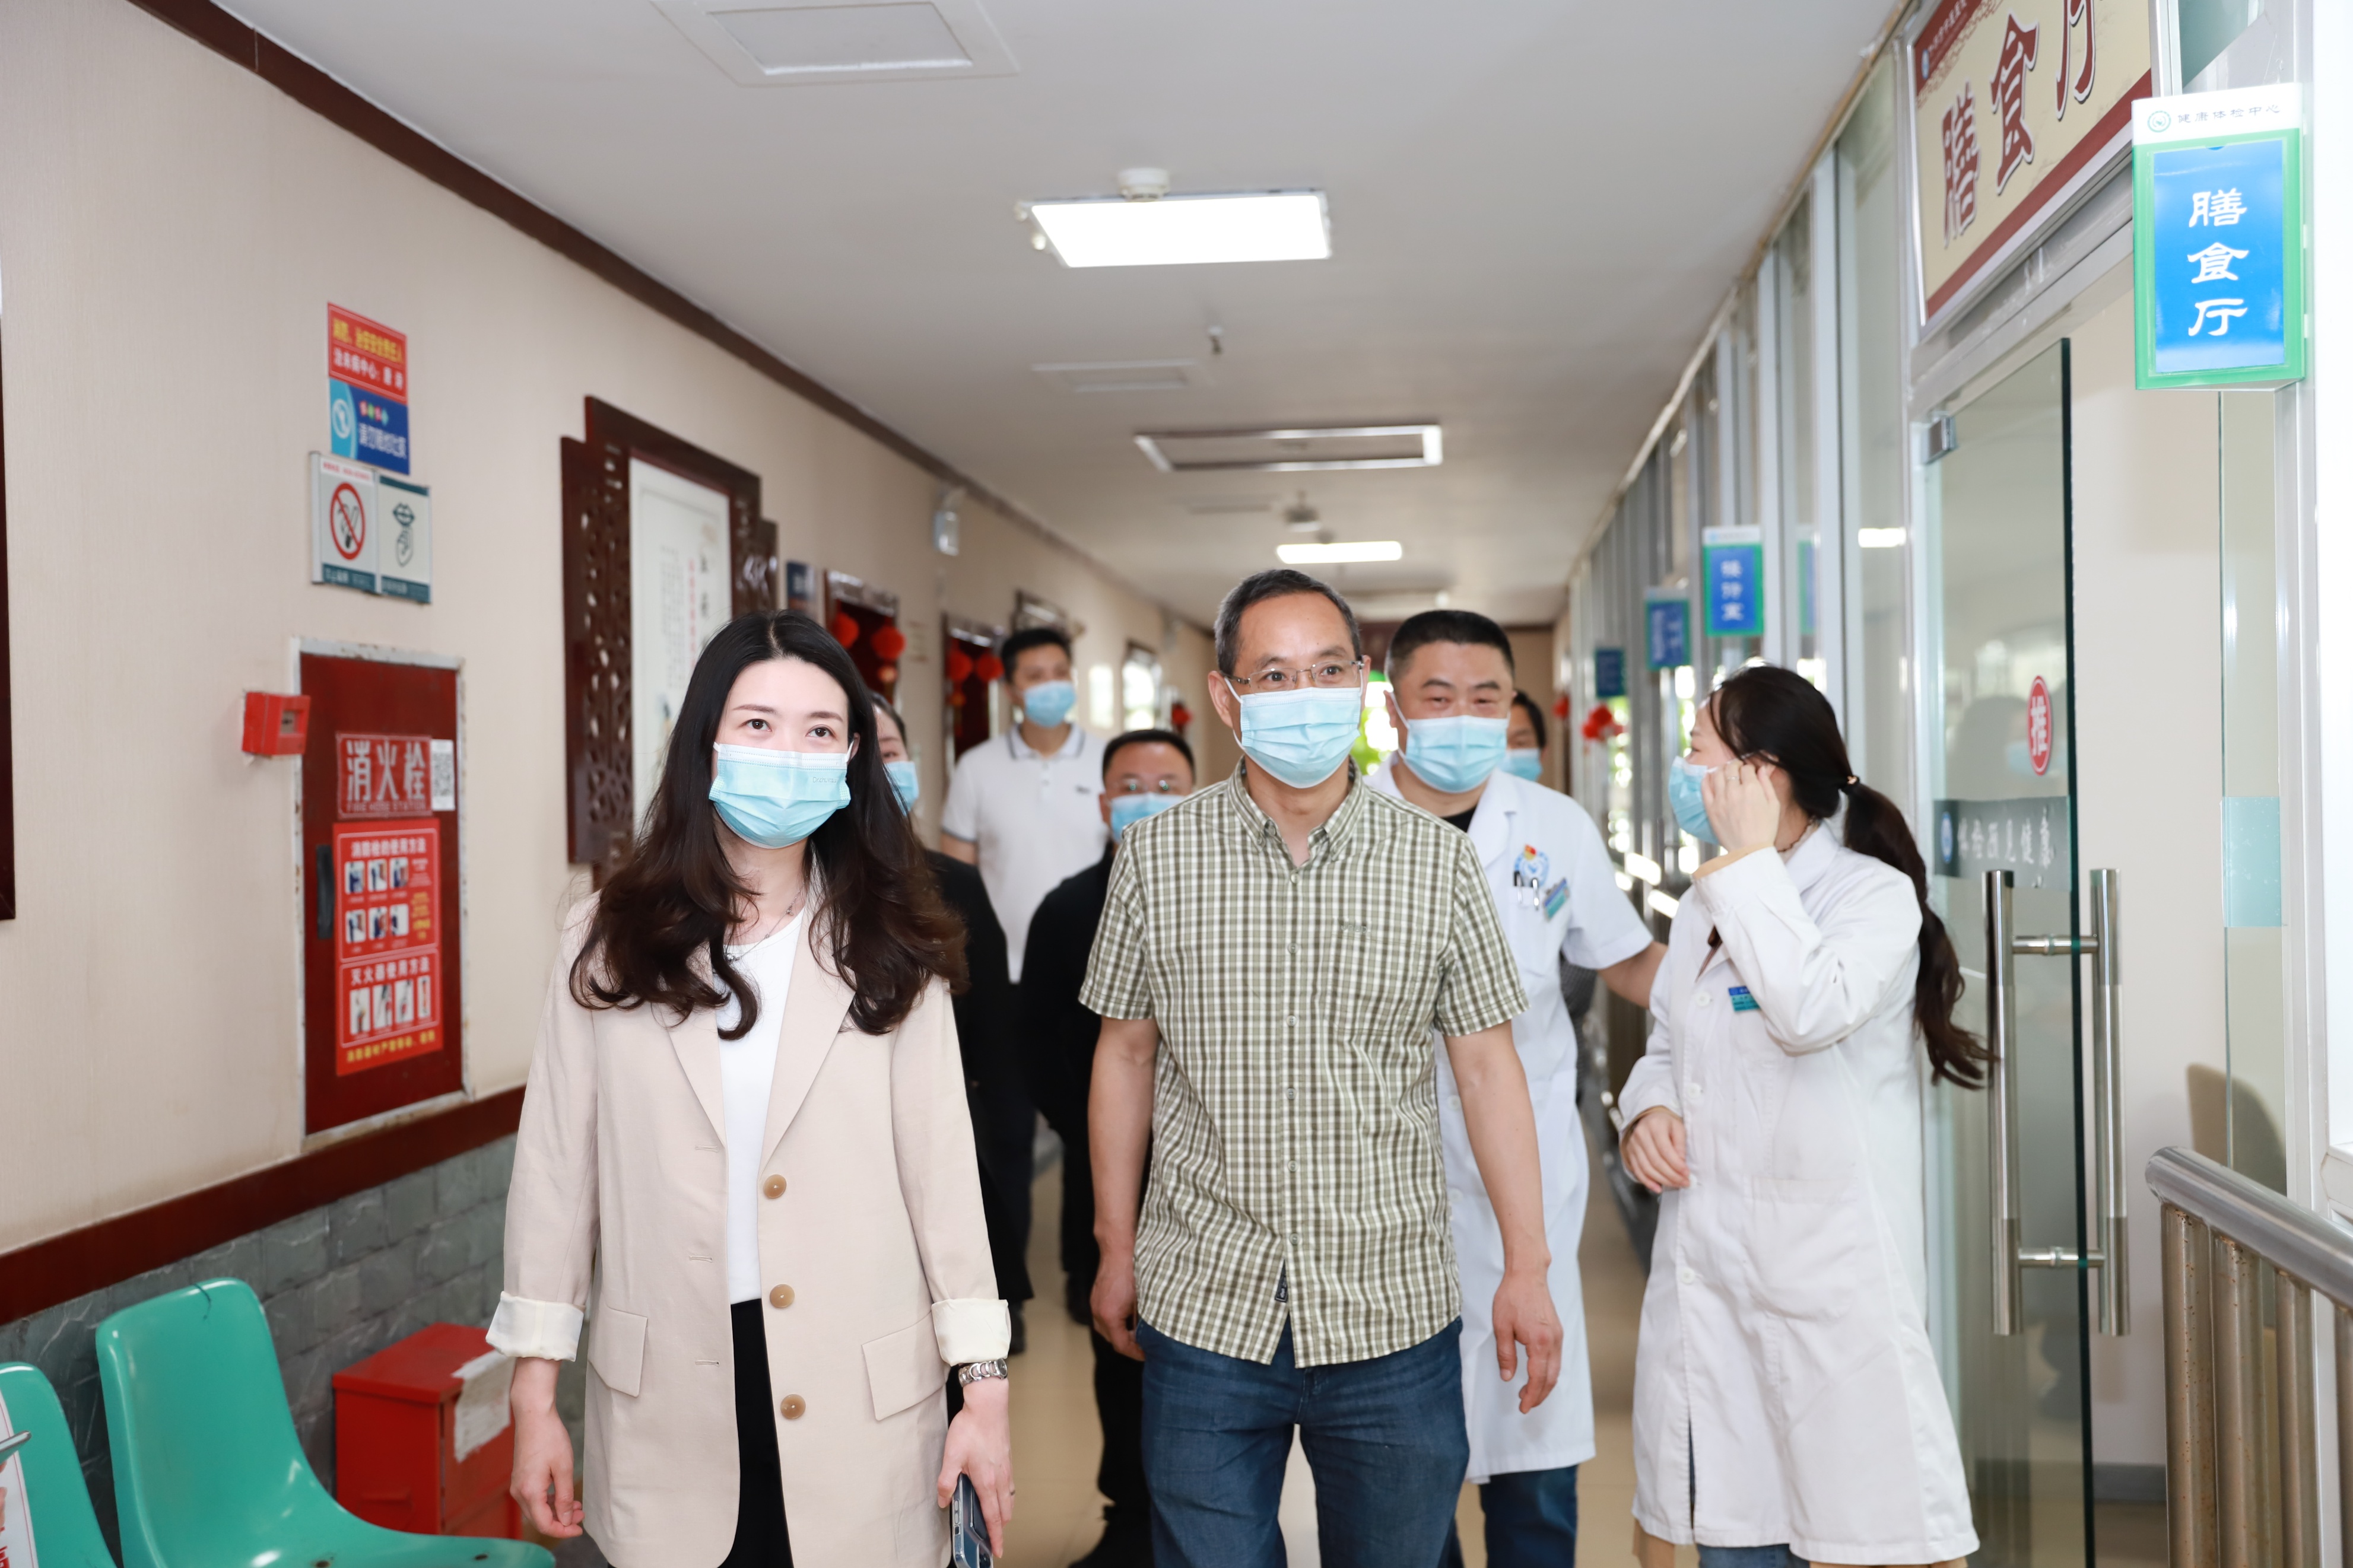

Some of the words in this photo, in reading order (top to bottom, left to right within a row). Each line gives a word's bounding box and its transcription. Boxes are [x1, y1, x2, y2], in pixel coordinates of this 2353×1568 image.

[2177, 104, 2281, 124] 健康体检中心
[2187, 187, 2249, 337] 膳食厅
[2030, 695, 2048, 756] 推
[346, 739, 425, 802] 消火栓
[351, 956, 430, 986] 灭火器使用方法
